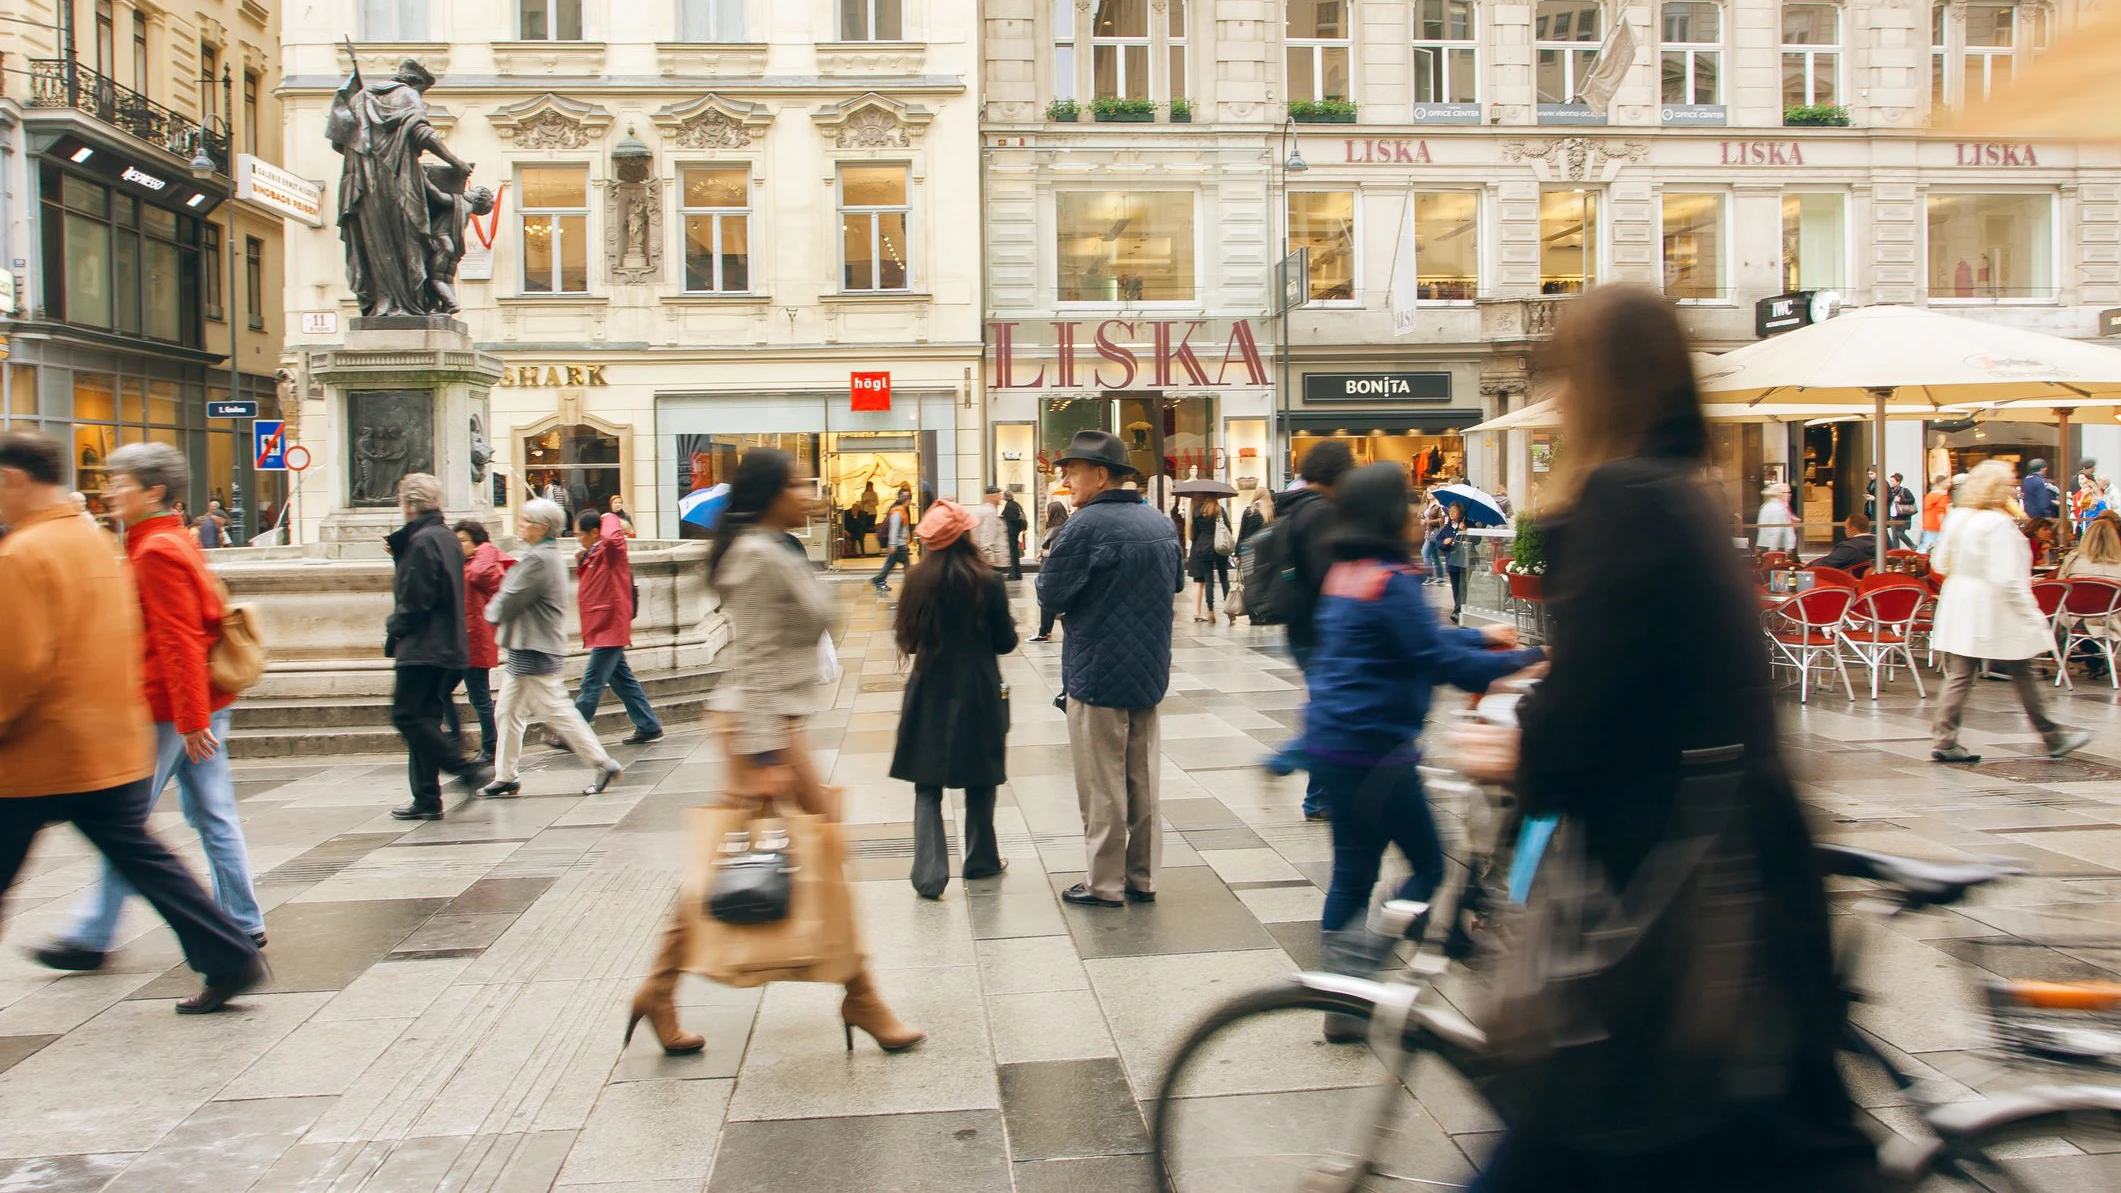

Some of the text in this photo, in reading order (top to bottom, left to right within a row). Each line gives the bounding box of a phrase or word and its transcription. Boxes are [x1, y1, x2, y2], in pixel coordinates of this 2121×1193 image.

[1344, 139, 1432, 163] LISKA
[1720, 141, 1804, 165] LISKA
[1954, 143, 2039, 166] LISKA
[1772, 299, 1793, 317] IWC
[313, 315, 326, 326] 11
[987, 319, 1275, 389] LISKA
[500, 364, 608, 387] SHARK
[1164, 447, 1226, 470] SALE
